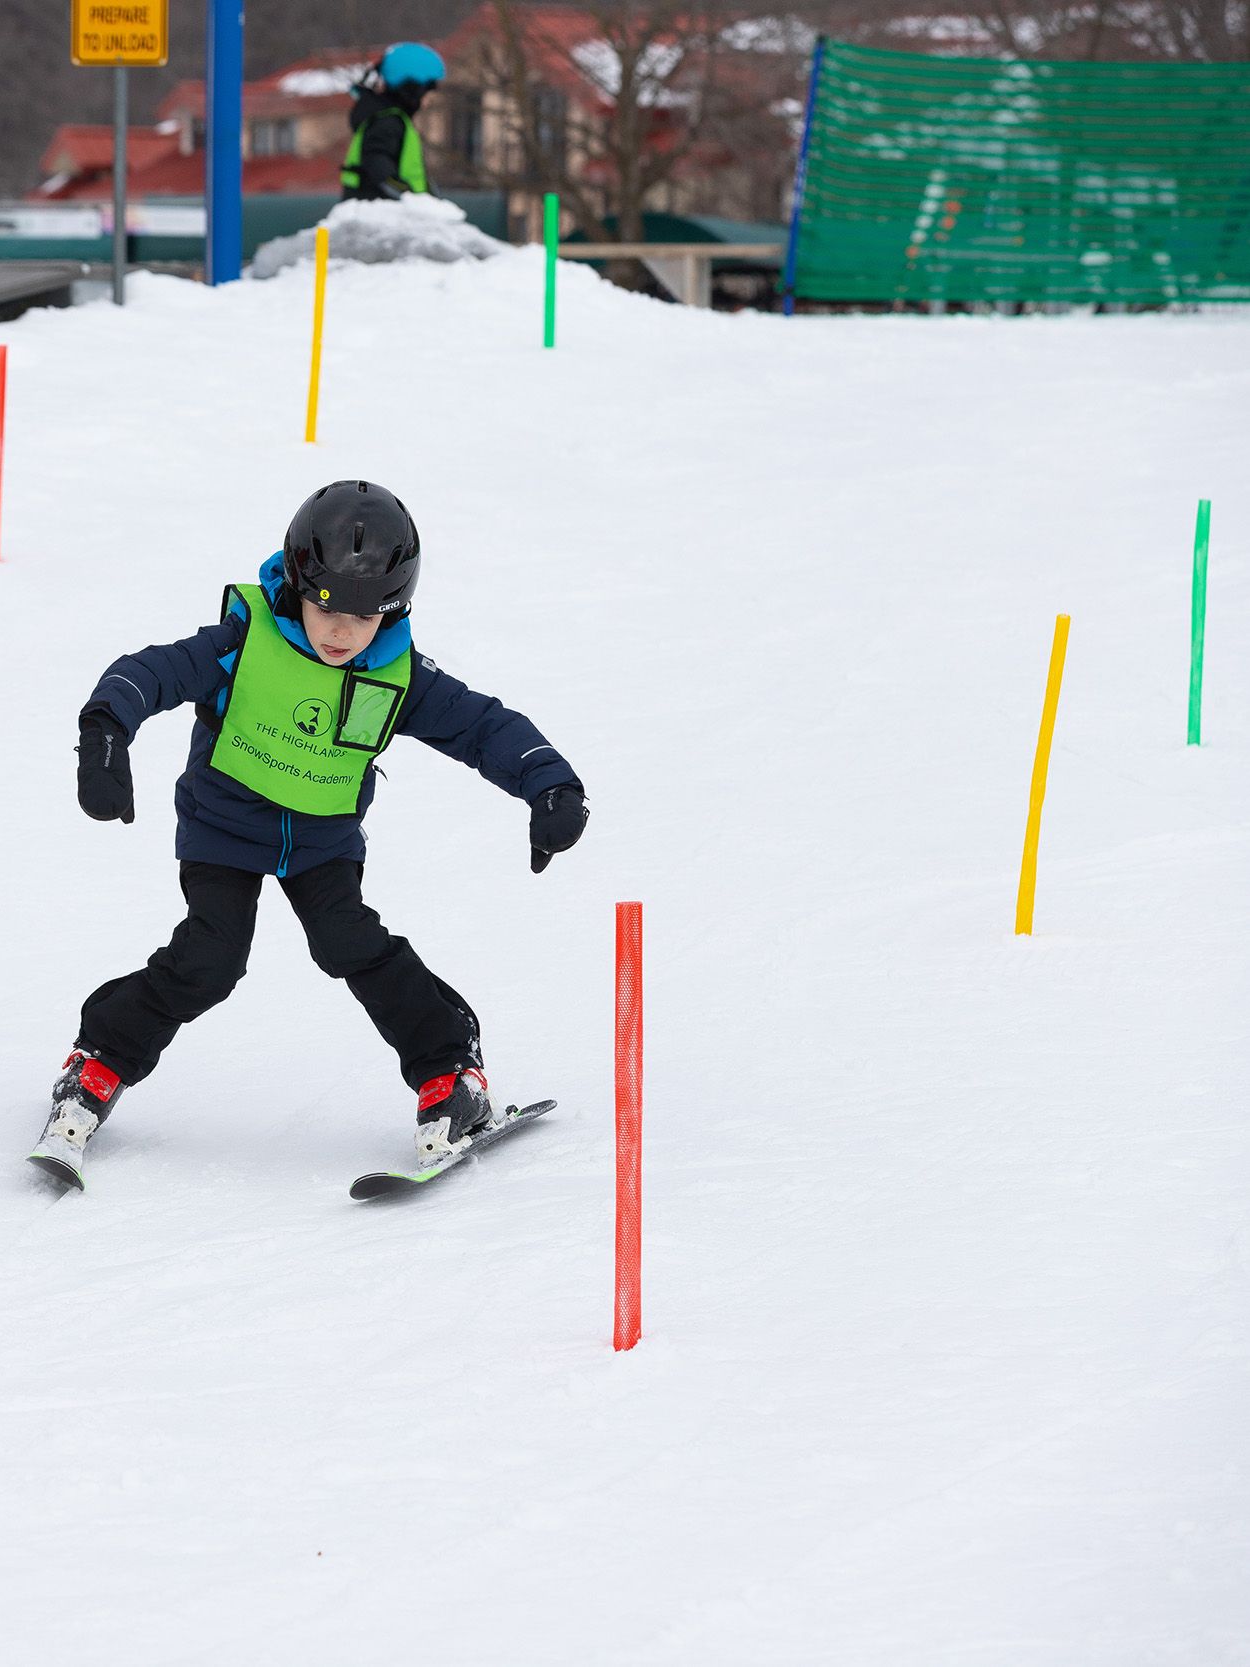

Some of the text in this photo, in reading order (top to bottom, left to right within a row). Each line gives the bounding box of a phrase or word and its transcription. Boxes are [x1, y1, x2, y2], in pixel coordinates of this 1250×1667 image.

[90, 6, 150, 24] PREPARE
[83, 32, 158, 52] TO UNLOAD
[378, 600, 400, 613] GIRO
[256, 722, 348, 759] THE HIGHLANDS
[231, 735, 354, 786] SnowSports Academy
